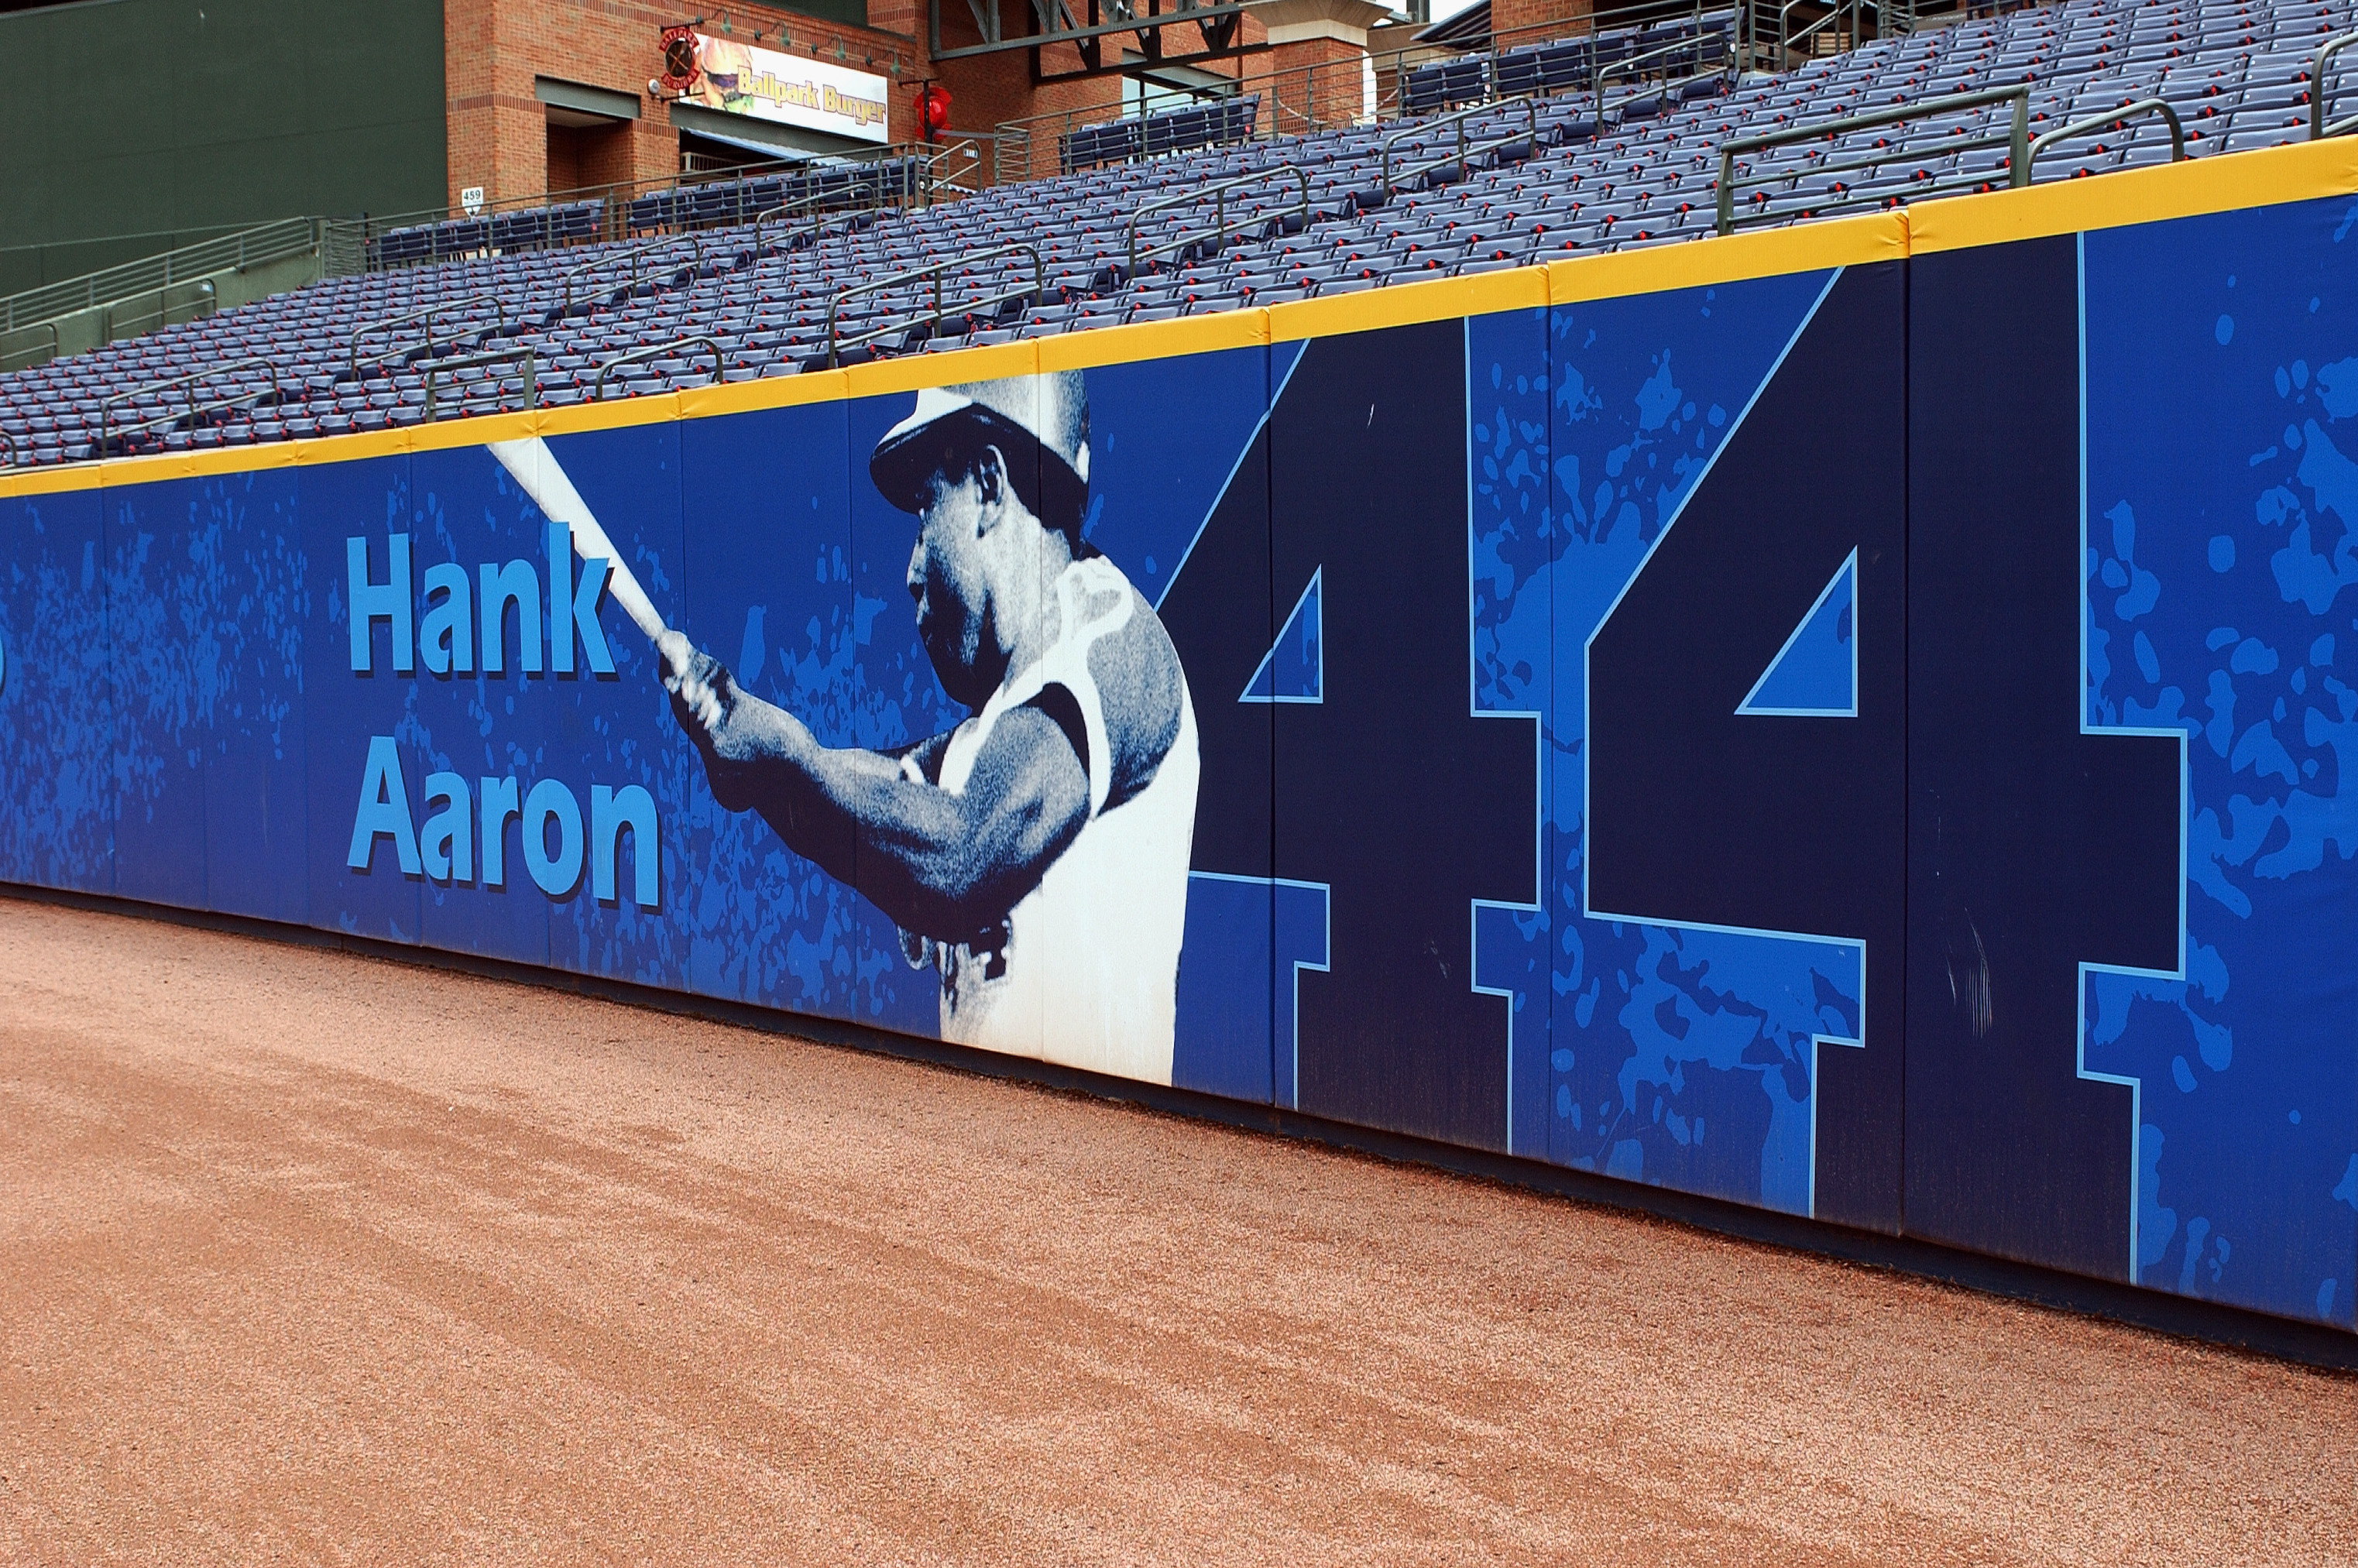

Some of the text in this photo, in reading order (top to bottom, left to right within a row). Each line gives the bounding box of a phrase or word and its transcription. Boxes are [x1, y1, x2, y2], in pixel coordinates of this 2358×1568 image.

[738, 65, 886, 125] Ballpark Burger
[464, 190, 480, 200] 459
[347, 521, 619, 677] Hank
[347, 736, 661, 909] Aaron
